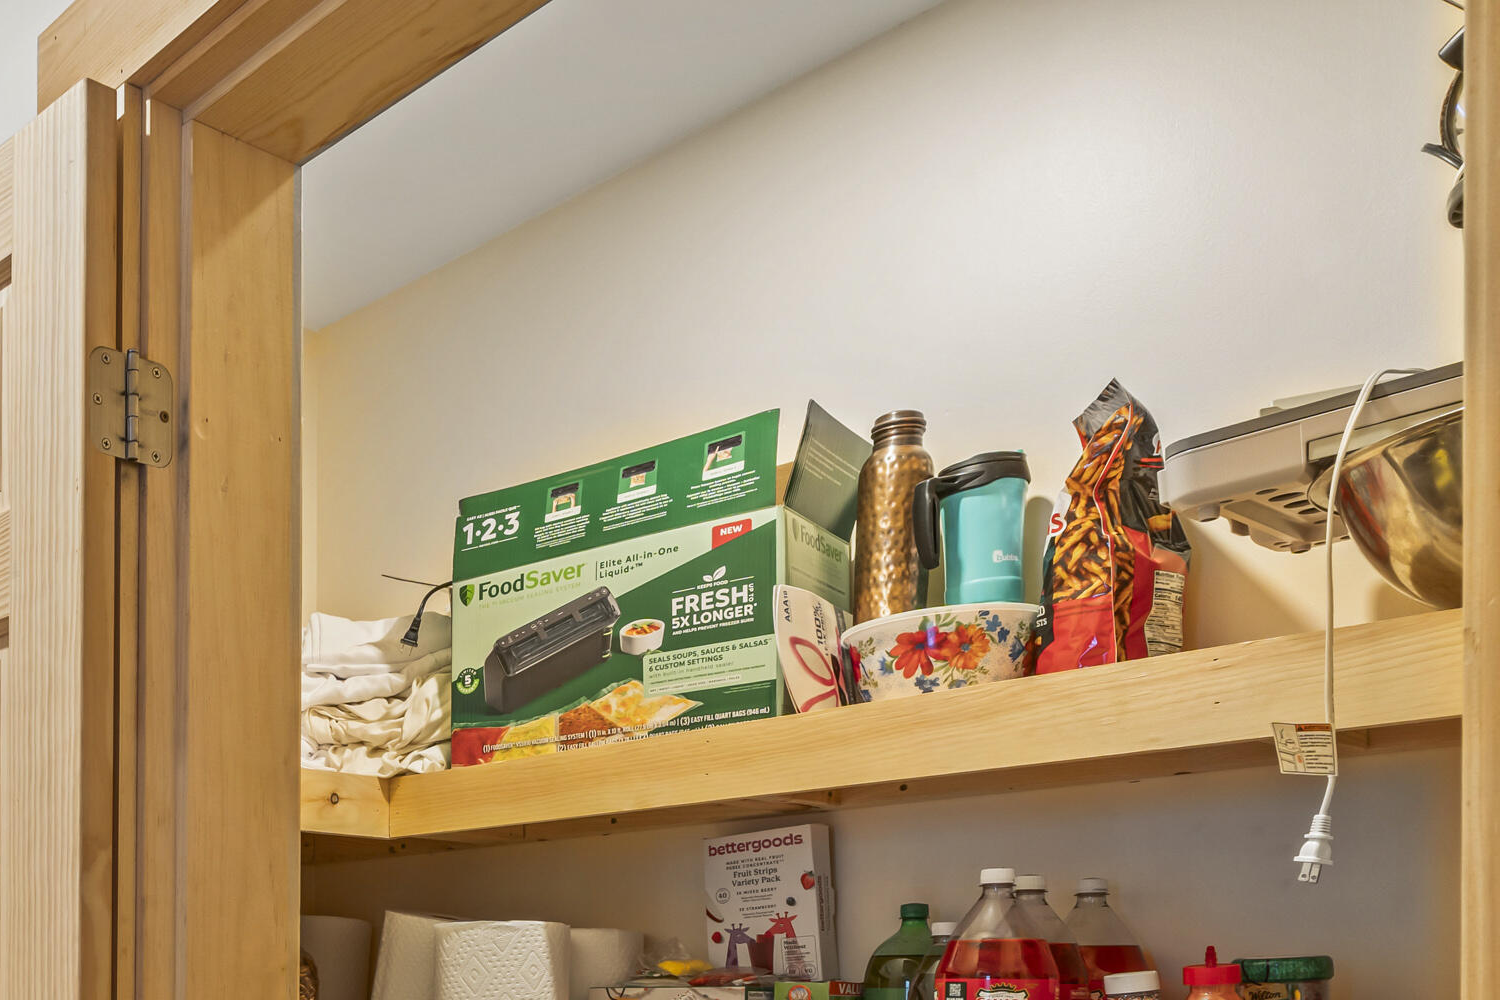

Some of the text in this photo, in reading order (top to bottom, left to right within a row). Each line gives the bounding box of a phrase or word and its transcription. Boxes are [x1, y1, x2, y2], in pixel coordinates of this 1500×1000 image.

[720, 523, 743, 536] NEW
[800, 524, 843, 562] FoodSaver
[599, 545, 679, 570] Elite All-in-One
[478, 563, 585, 601] FoodSaver
[713, 579, 729, 588] FOOD
[671, 584, 748, 617] FRESH
[671, 616, 690, 630] 5X
[648, 655, 671, 665] SEALS
[672, 650, 699, 662] SOUPS,
[700, 646, 730, 657] SAUCES
[648, 654, 724, 673] 6 CUSTOM SETTINGS
[690, 716, 703, 724] EASY
[703, 714, 715, 723] FILL
[714, 711, 732, 721] QUART
[731, 709, 747, 718] BAGS
[708, 833, 803, 856] bettergoods
[731, 875, 781, 887] Variety Pack
[733, 867, 778, 879] Fruit Strips
